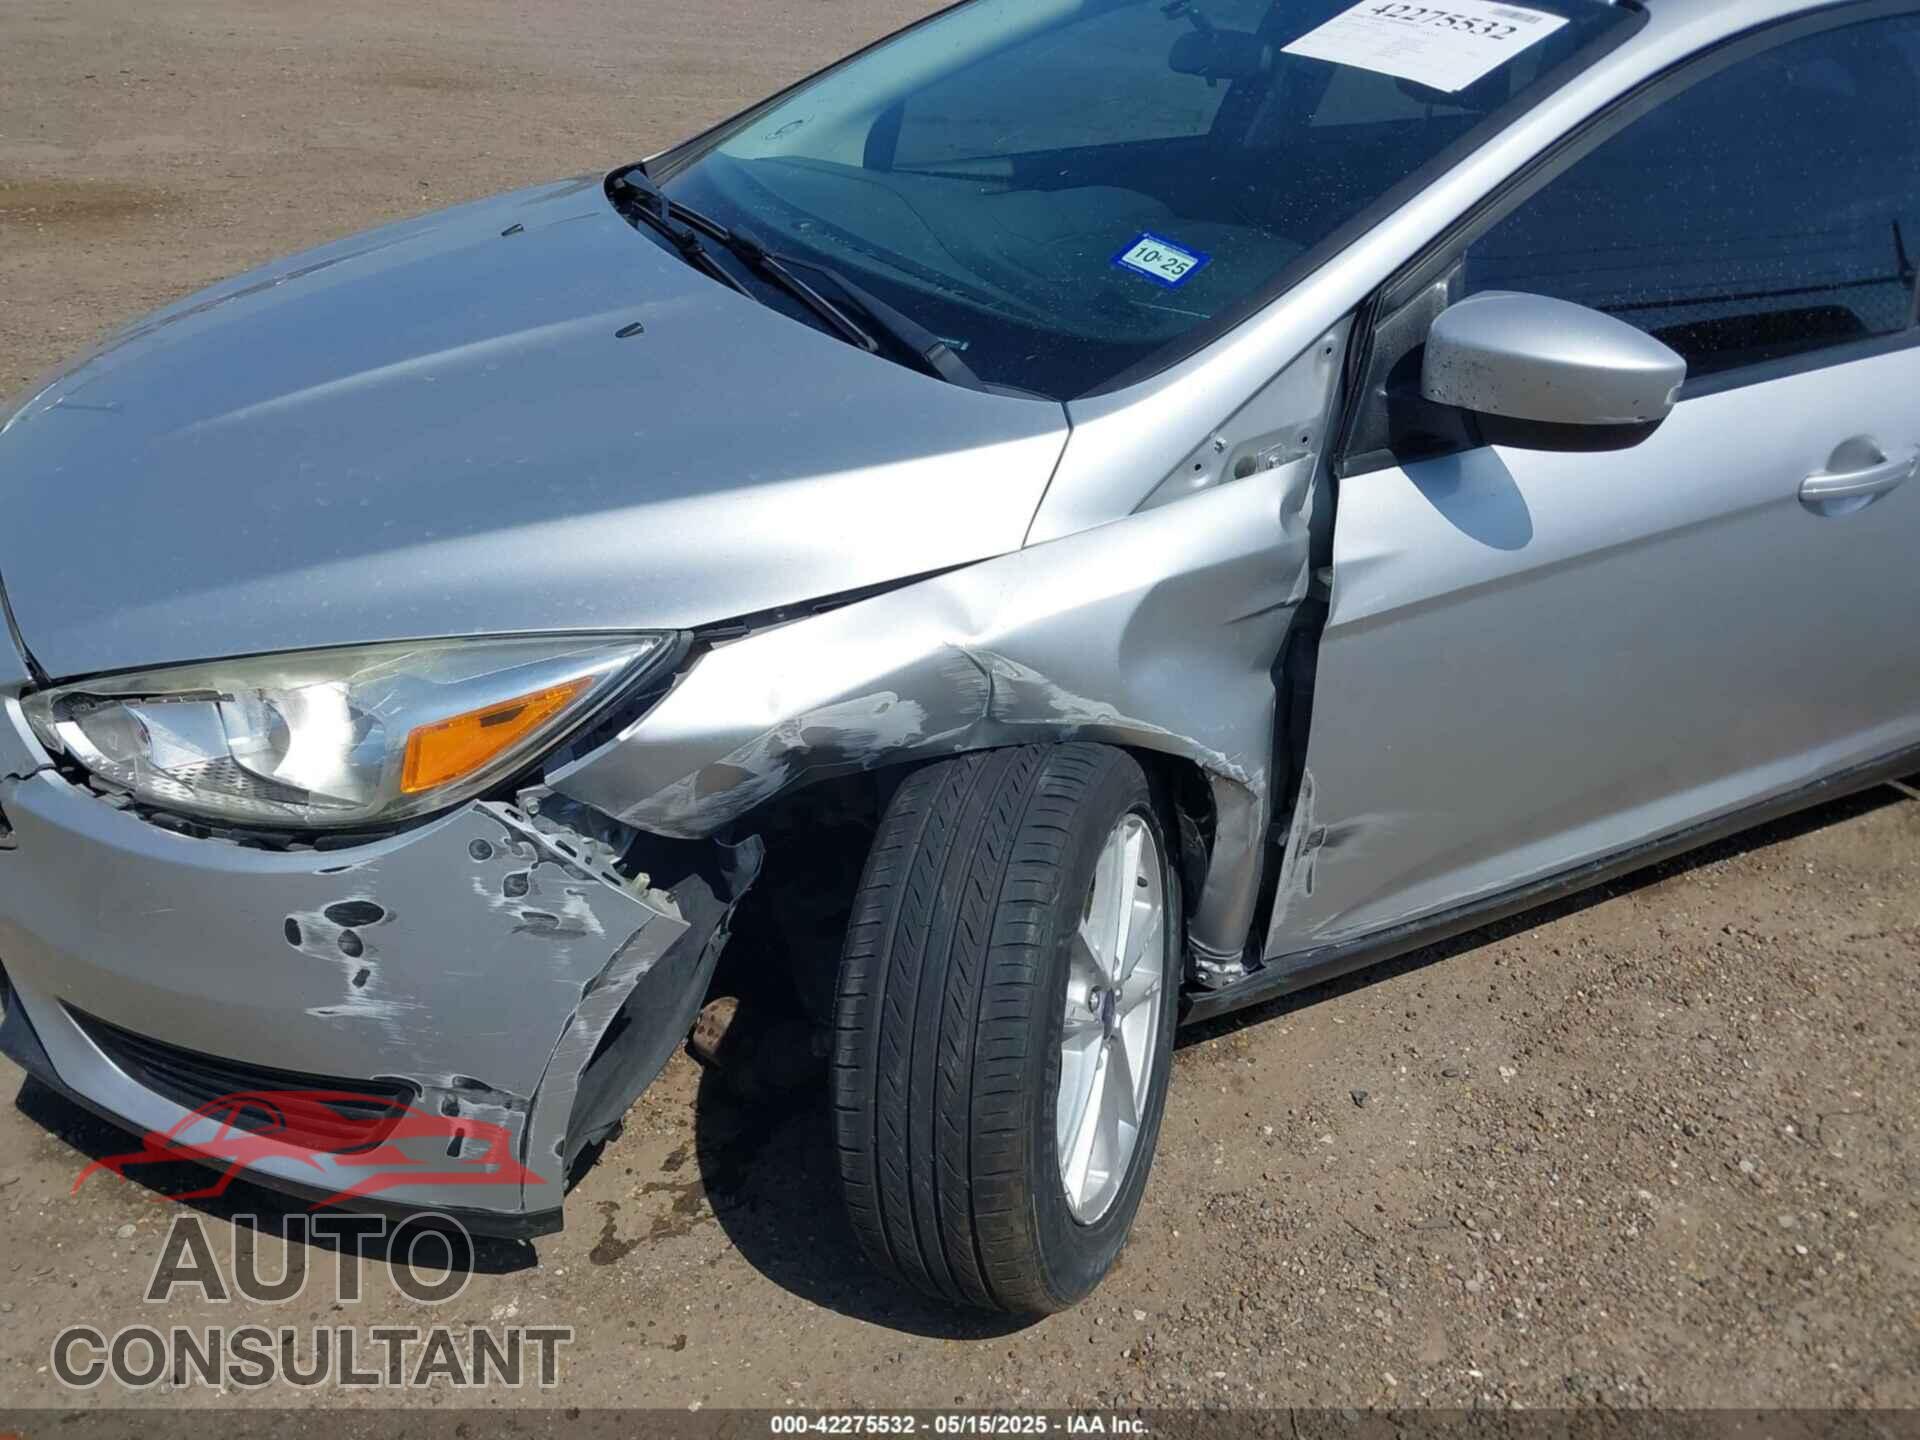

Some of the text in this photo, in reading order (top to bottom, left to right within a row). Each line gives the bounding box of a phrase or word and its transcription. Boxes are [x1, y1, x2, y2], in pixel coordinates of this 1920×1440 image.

[1371, 3, 1517, 40] 42275532
[1135, 247, 1159, 262] 10
[1160, 257, 1189, 275] 25
